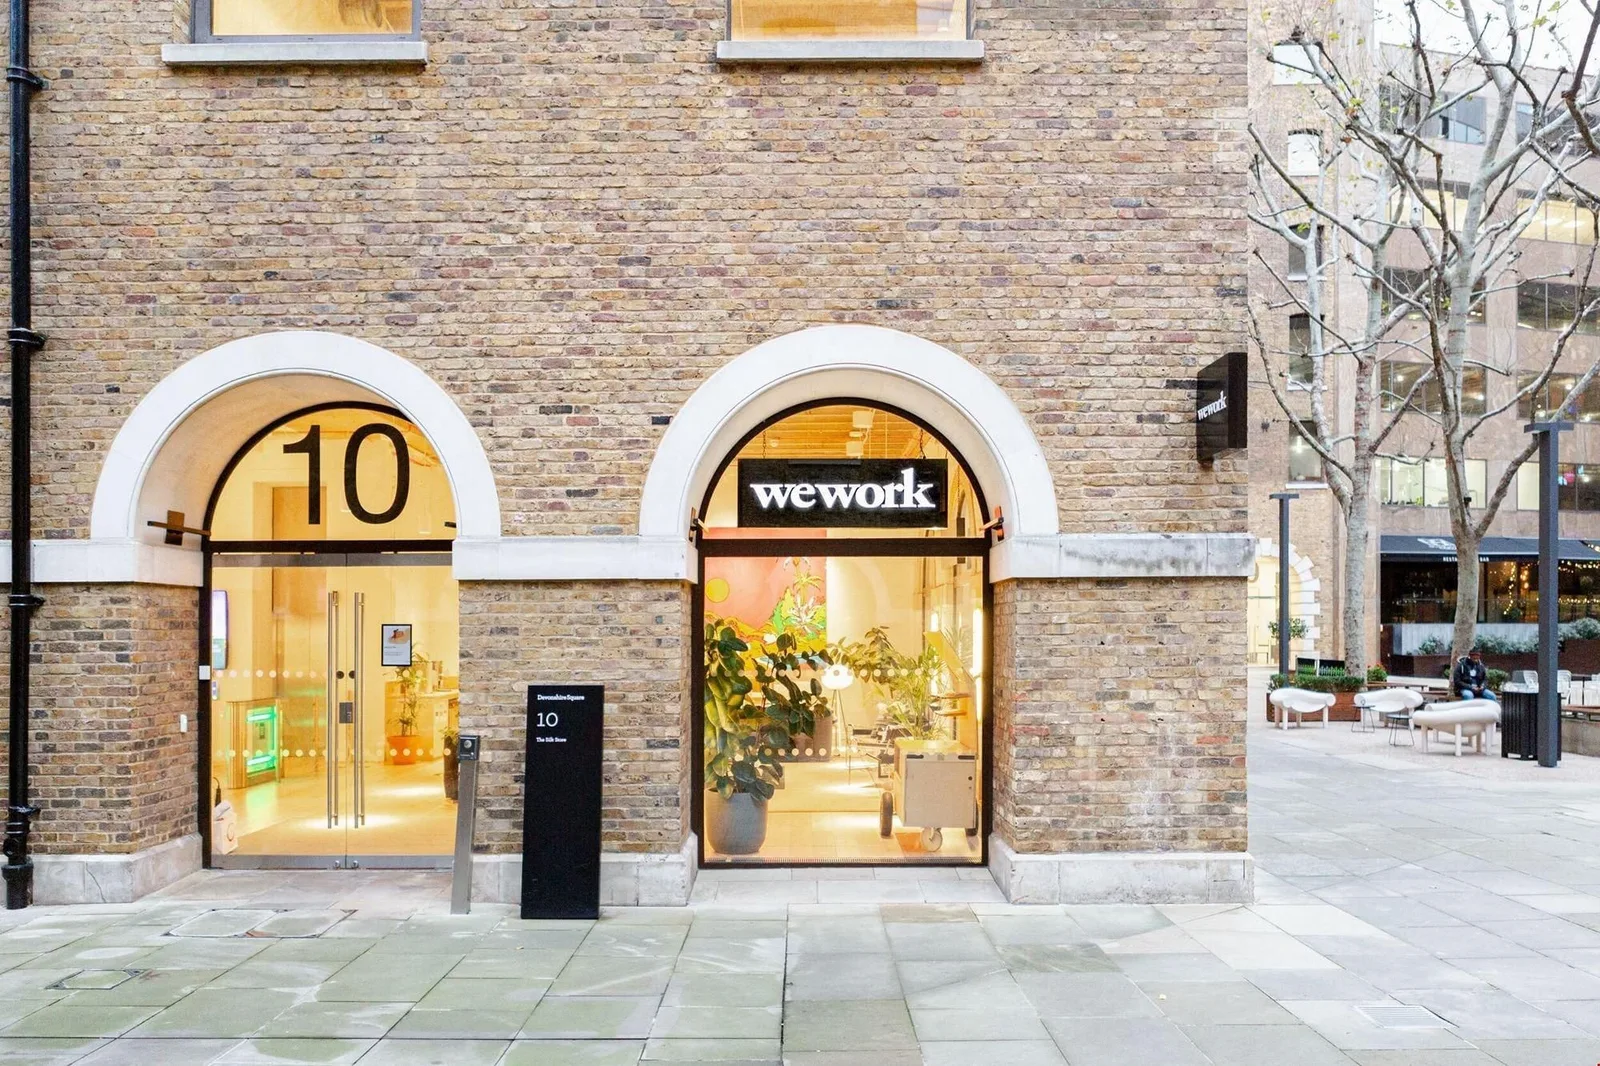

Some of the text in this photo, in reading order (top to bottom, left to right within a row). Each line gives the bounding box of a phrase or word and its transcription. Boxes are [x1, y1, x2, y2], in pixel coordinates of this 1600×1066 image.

[1197, 390, 1227, 420] wework
[283, 422, 410, 525] 10
[749, 467, 936, 509] wework
[536, 712, 559, 728] 10
